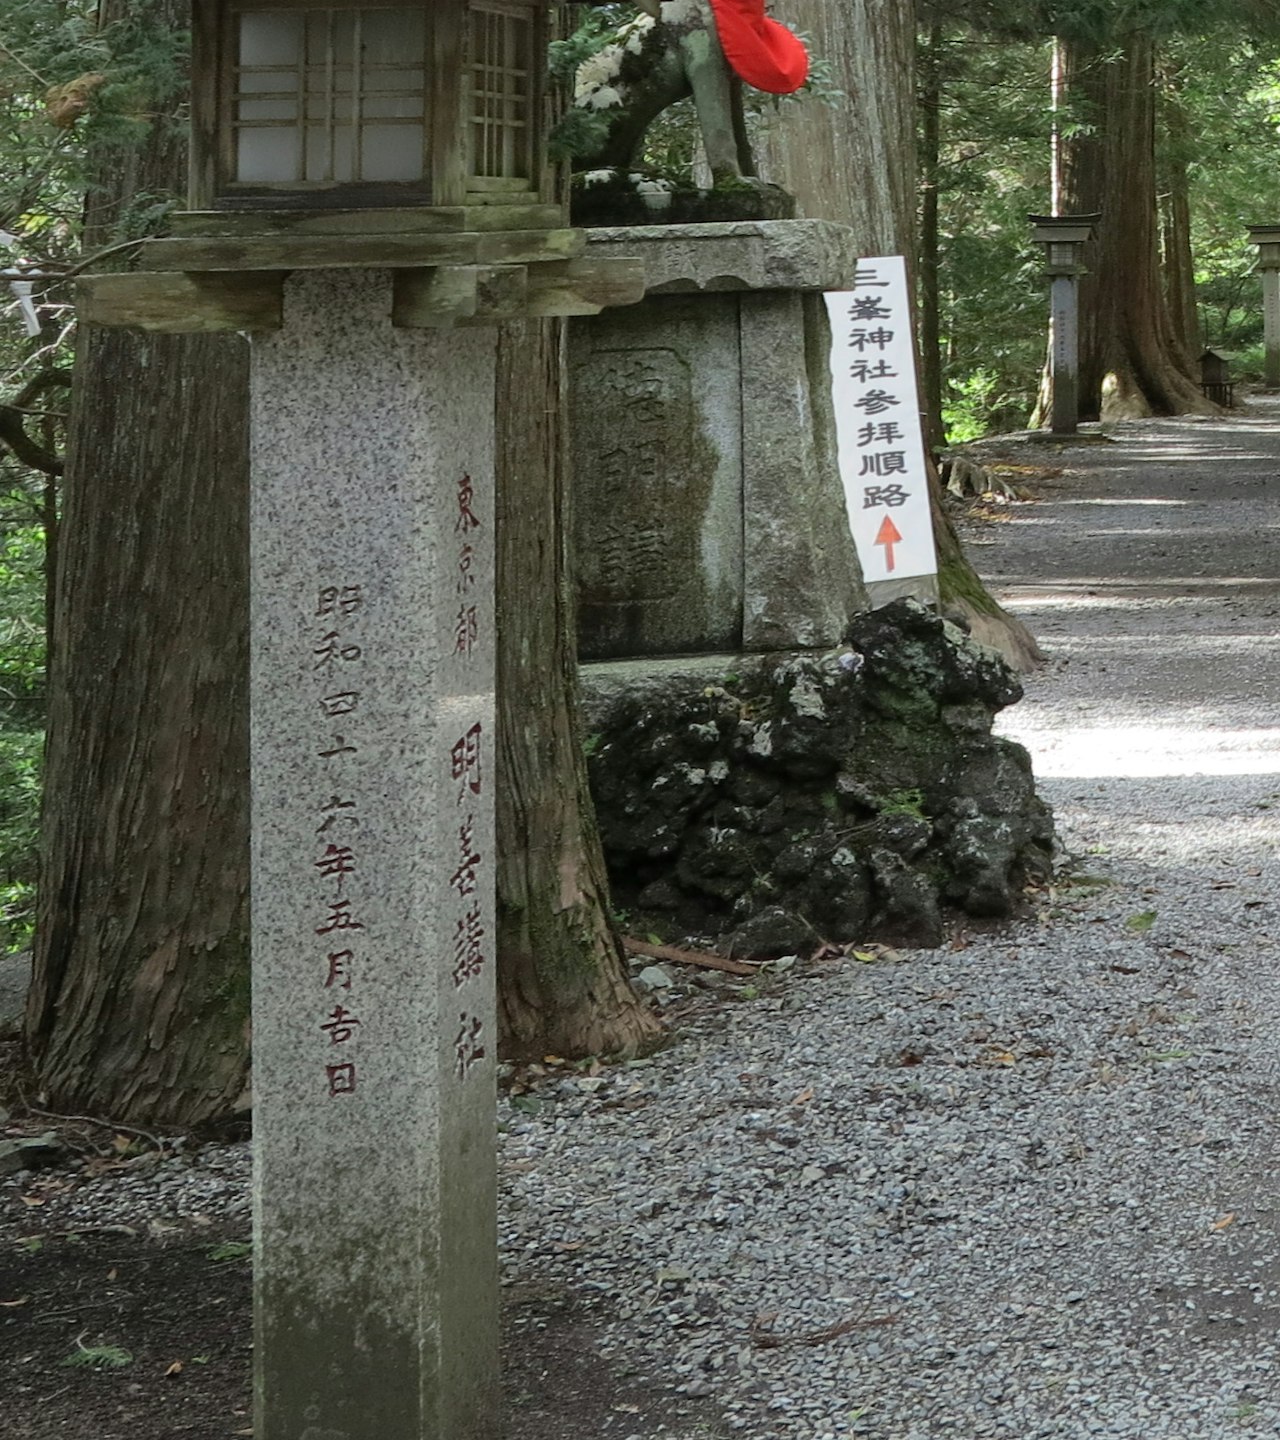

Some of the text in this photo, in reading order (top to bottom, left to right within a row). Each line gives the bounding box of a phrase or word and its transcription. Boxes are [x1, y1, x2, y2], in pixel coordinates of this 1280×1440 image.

[847, 268, 913, 510] 三峯神社参拝順路
[311, 584, 363, 1099] 昭和四十六年五月吉日
[447, 470, 488, 1084] 東京都 明善講社
